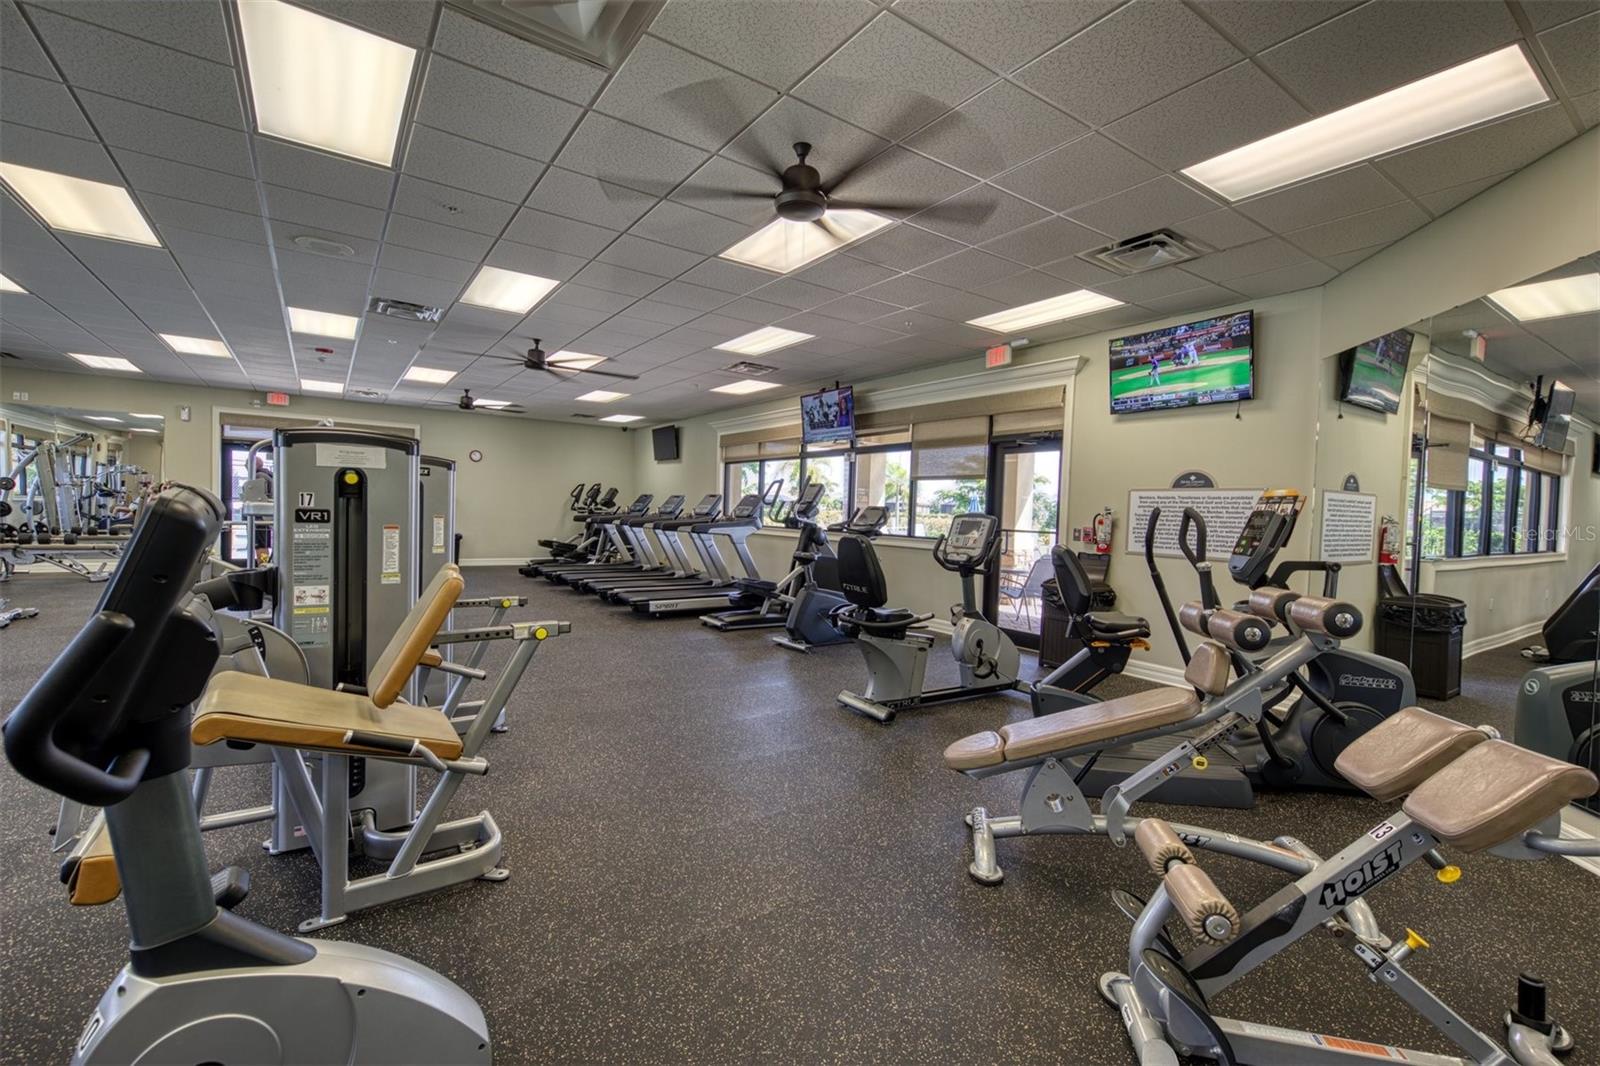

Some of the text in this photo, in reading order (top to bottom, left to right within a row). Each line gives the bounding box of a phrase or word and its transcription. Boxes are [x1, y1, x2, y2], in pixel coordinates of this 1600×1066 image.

[299, 493, 313, 507] 17
[298, 511, 328, 521] VR1
[1370, 822, 1394, 839] 13
[1179, 832, 1213, 848] IST
[1321, 840, 1403, 909] HOIST
[1356, 945, 1366, 954] 35
[1384, 969, 1396, 979] 45
